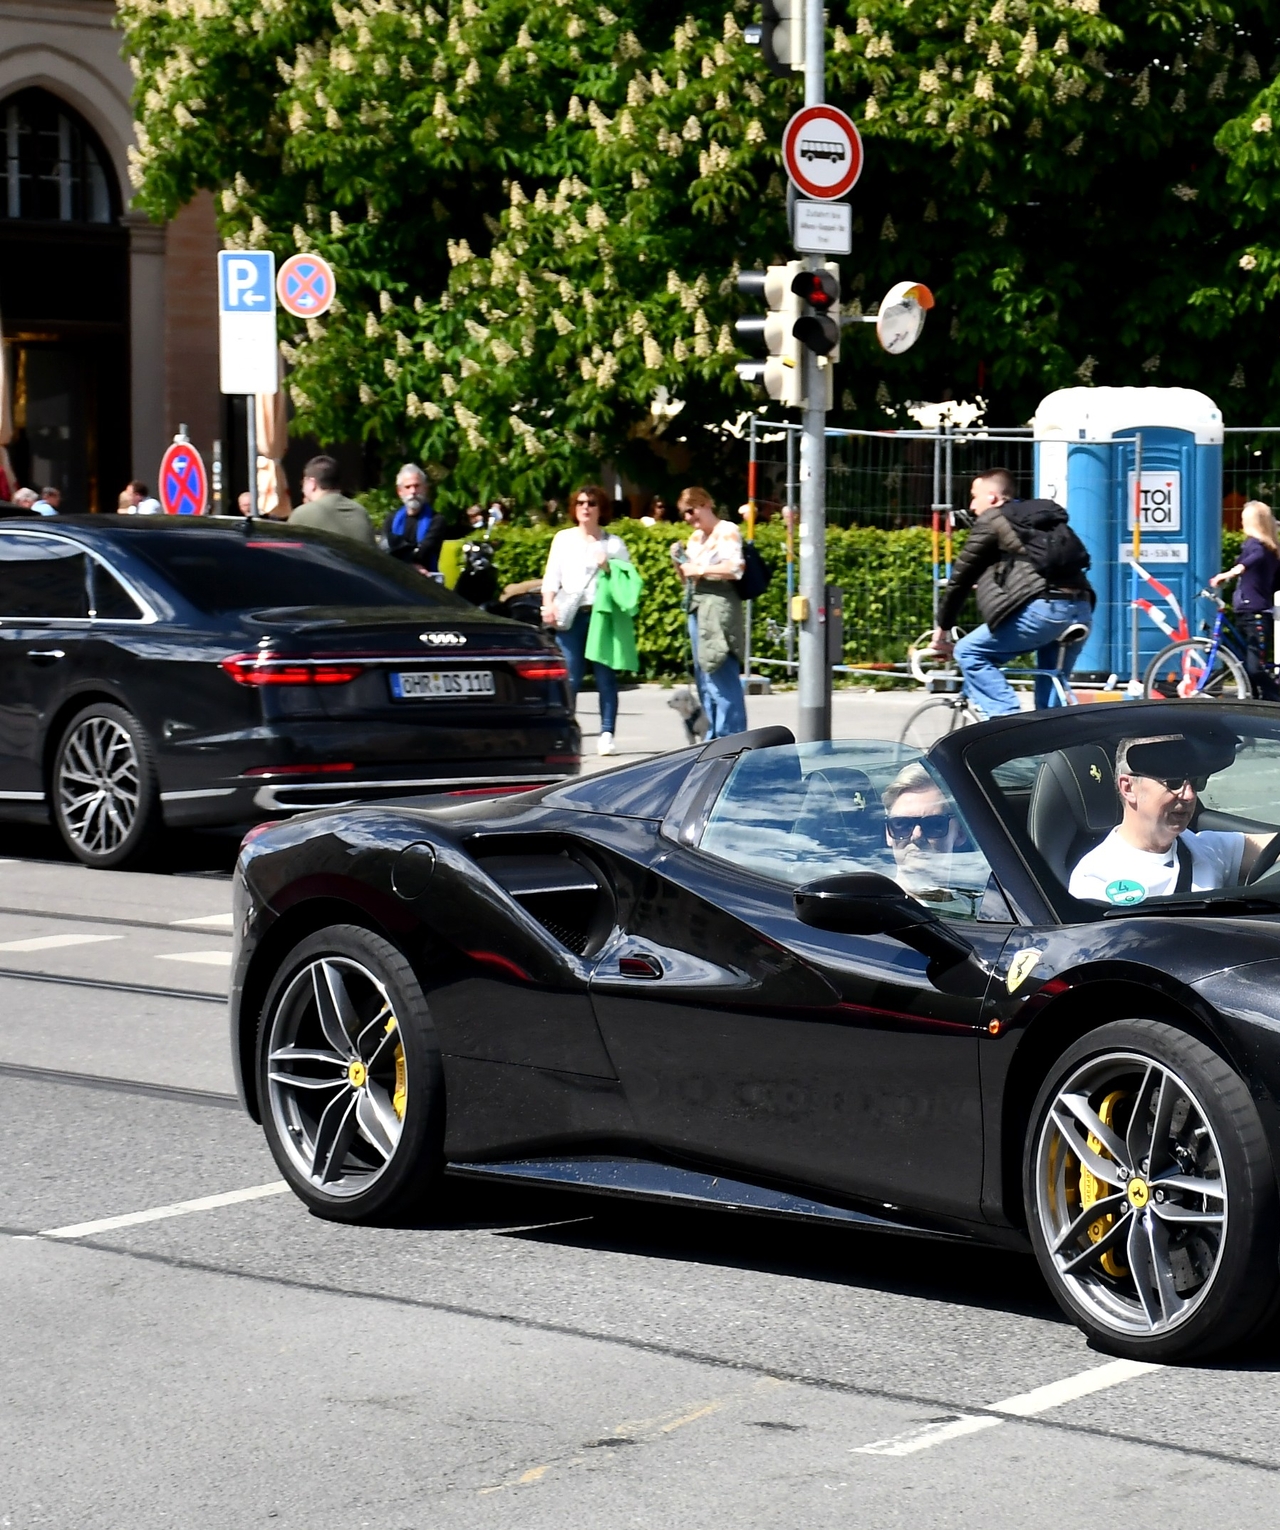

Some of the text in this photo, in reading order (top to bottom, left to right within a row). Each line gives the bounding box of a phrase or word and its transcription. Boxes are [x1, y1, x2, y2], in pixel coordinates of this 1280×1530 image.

[227, 258, 258, 307] P
[1140, 489, 1171, 506] TOI
[1140, 507, 1171, 523] TOI
[442, 674, 462, 694] DS
